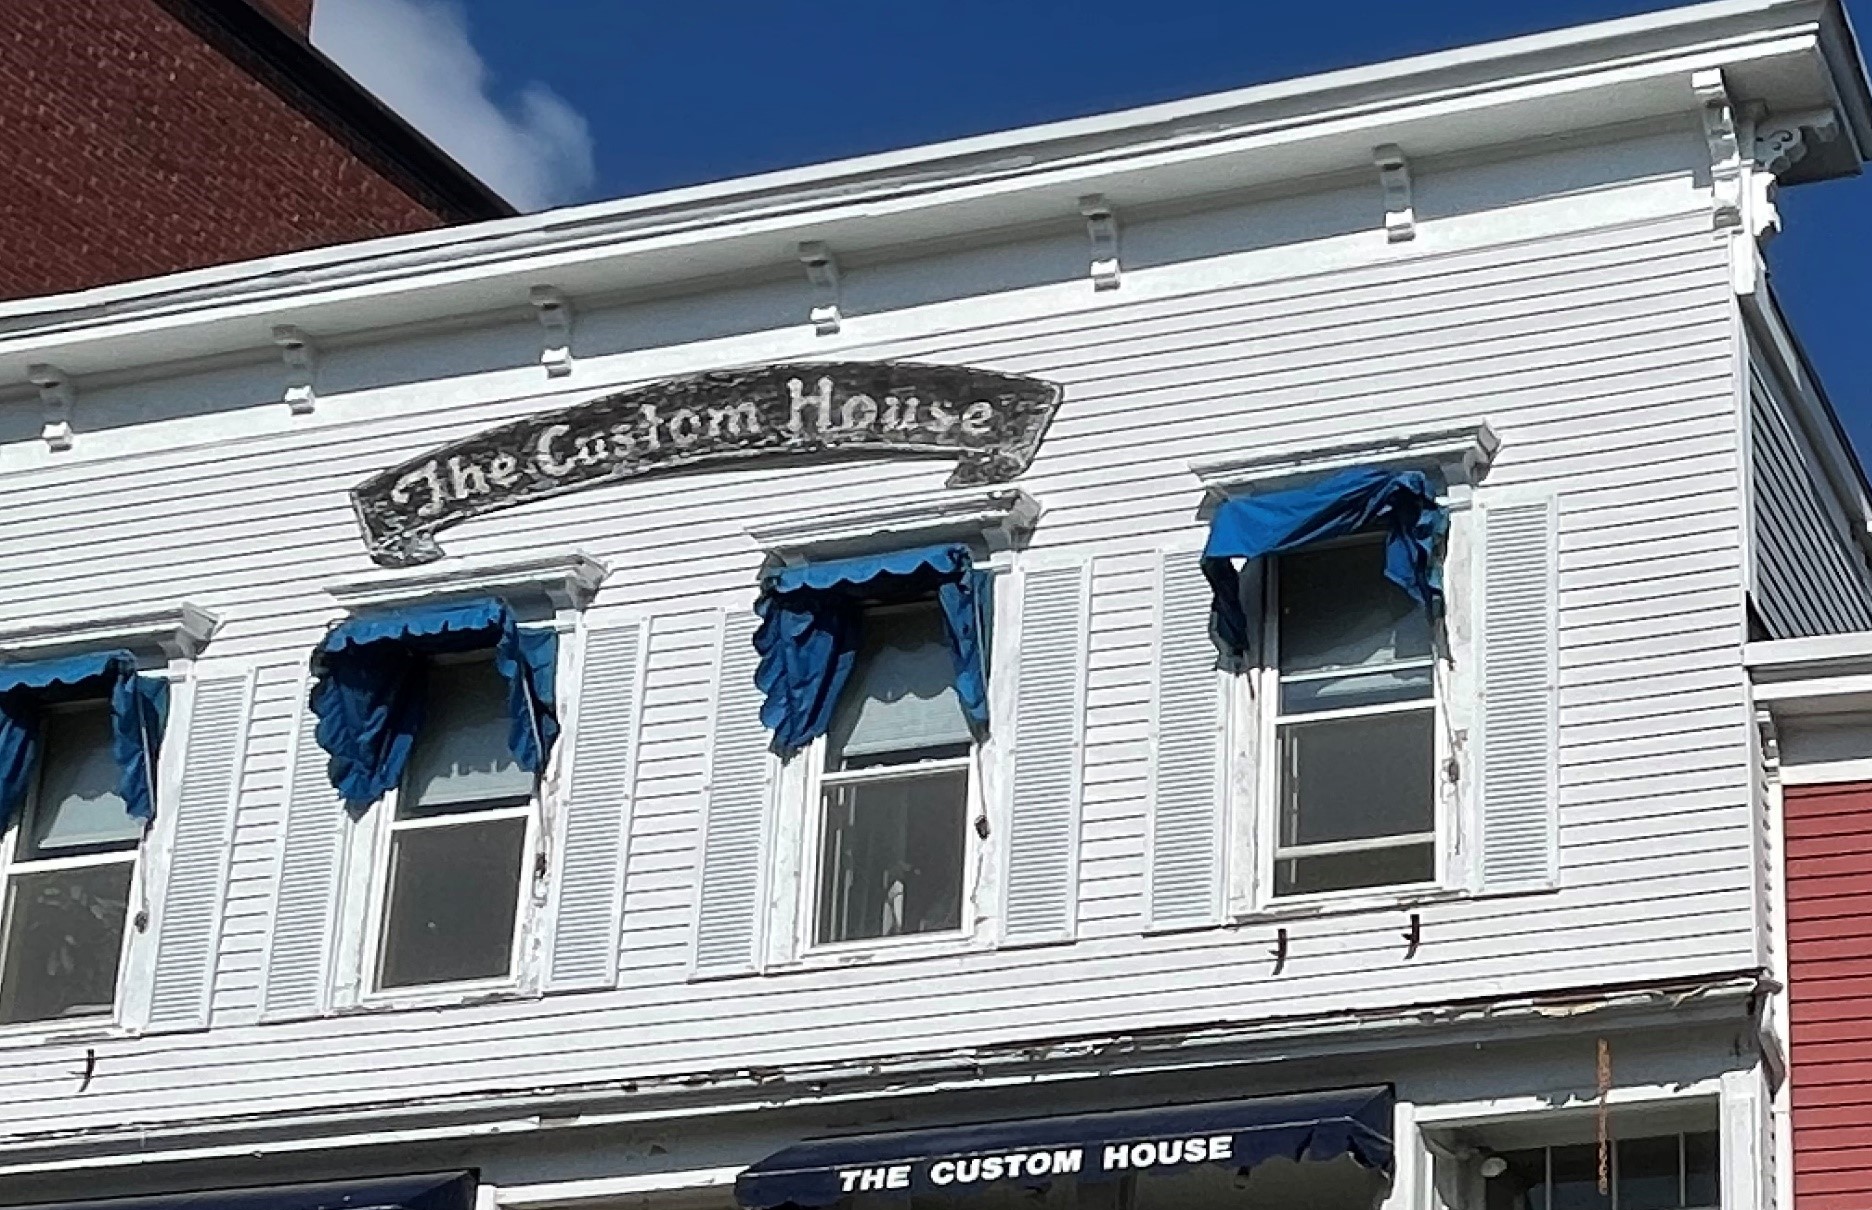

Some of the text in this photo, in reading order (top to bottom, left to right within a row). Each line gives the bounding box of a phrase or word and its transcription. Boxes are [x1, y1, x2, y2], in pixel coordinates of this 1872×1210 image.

[391, 377, 994, 516] The Custom House
[840, 1136, 1233, 1193] THE CUSTOM HOUSE
